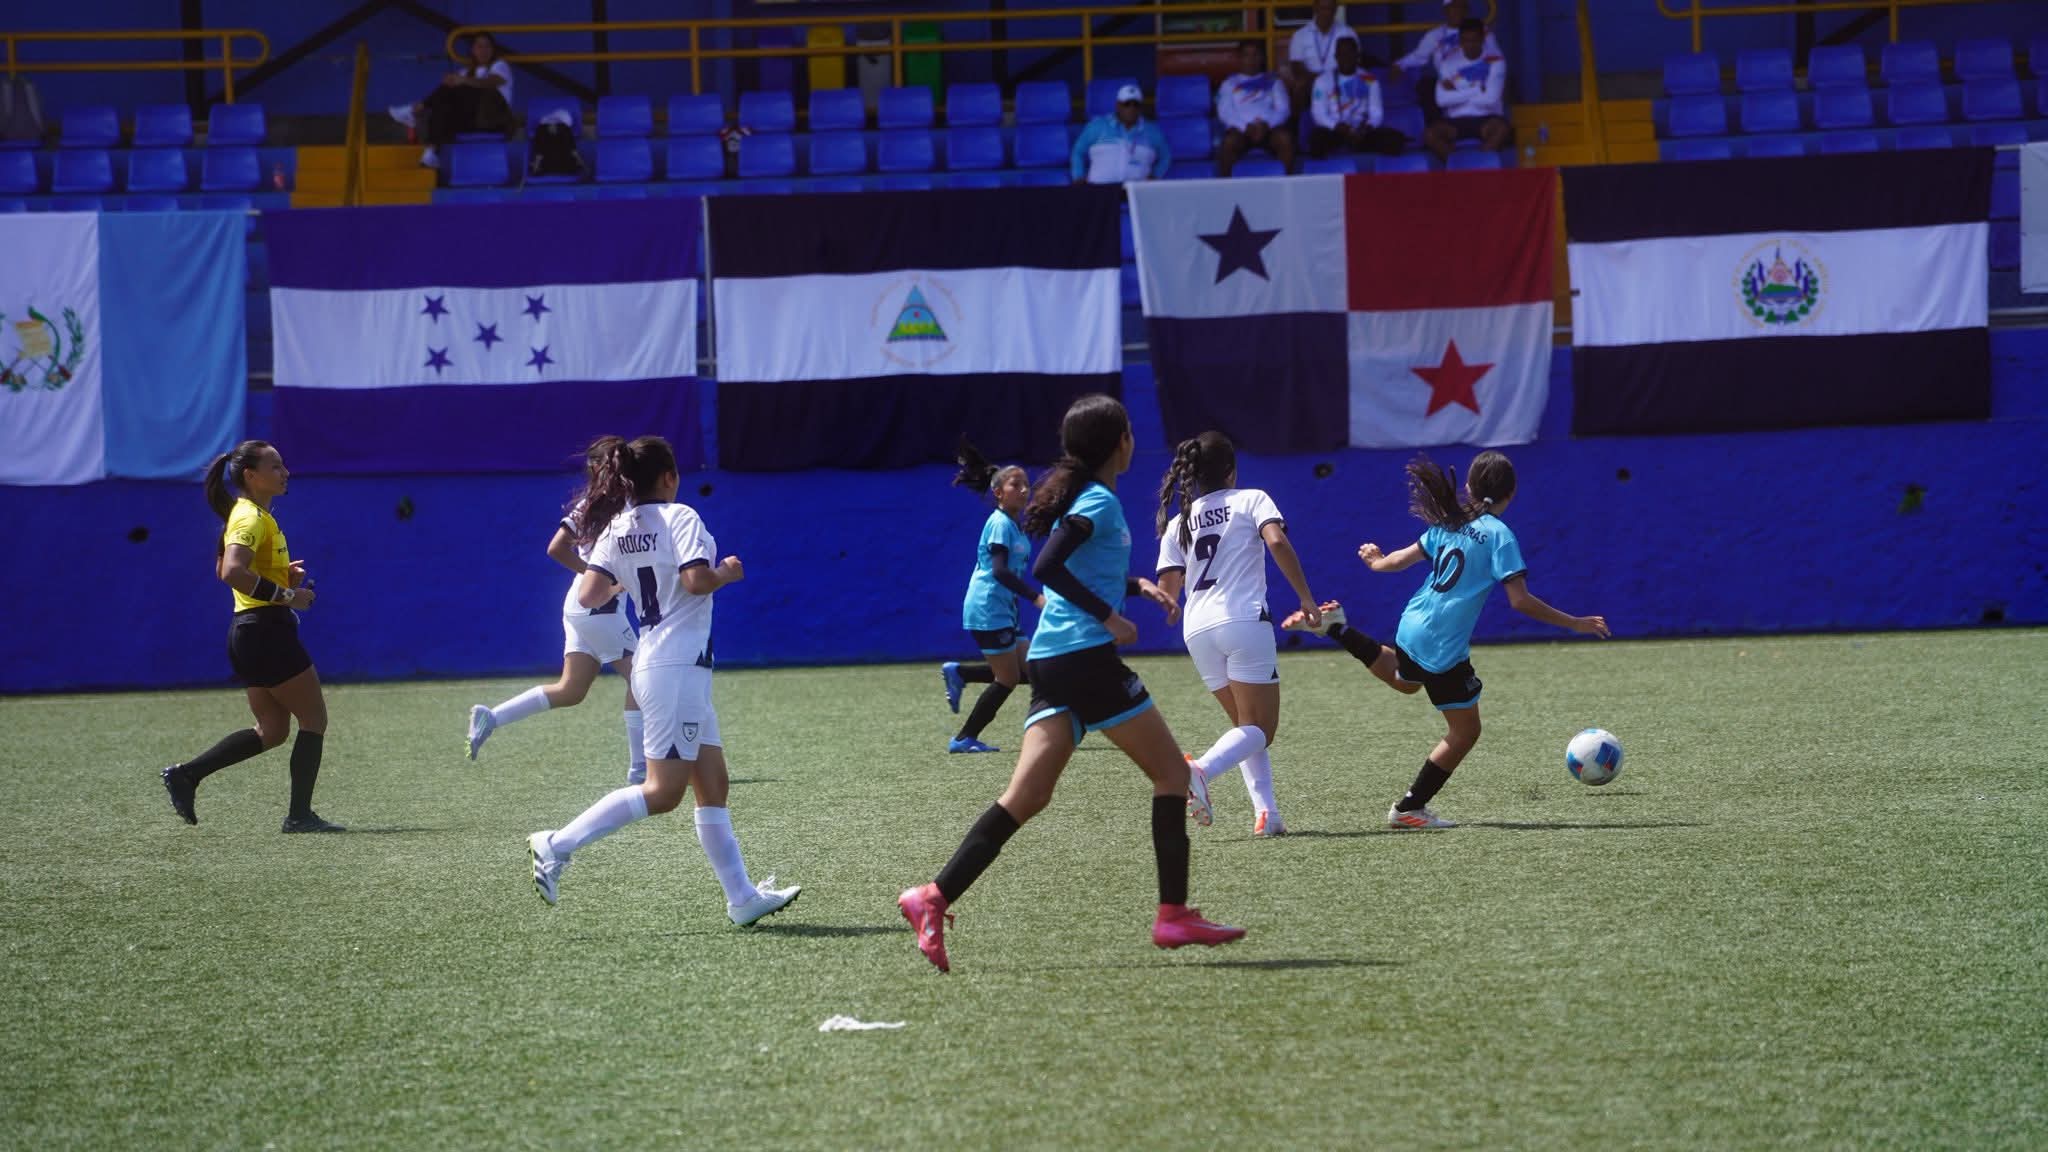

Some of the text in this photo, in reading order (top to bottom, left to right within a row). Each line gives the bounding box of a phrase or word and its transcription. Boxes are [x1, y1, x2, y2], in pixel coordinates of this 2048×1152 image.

[617, 533, 658, 555] ROUSY
[1192, 533, 1222, 593] 2
[1430, 543, 1465, 593] 10
